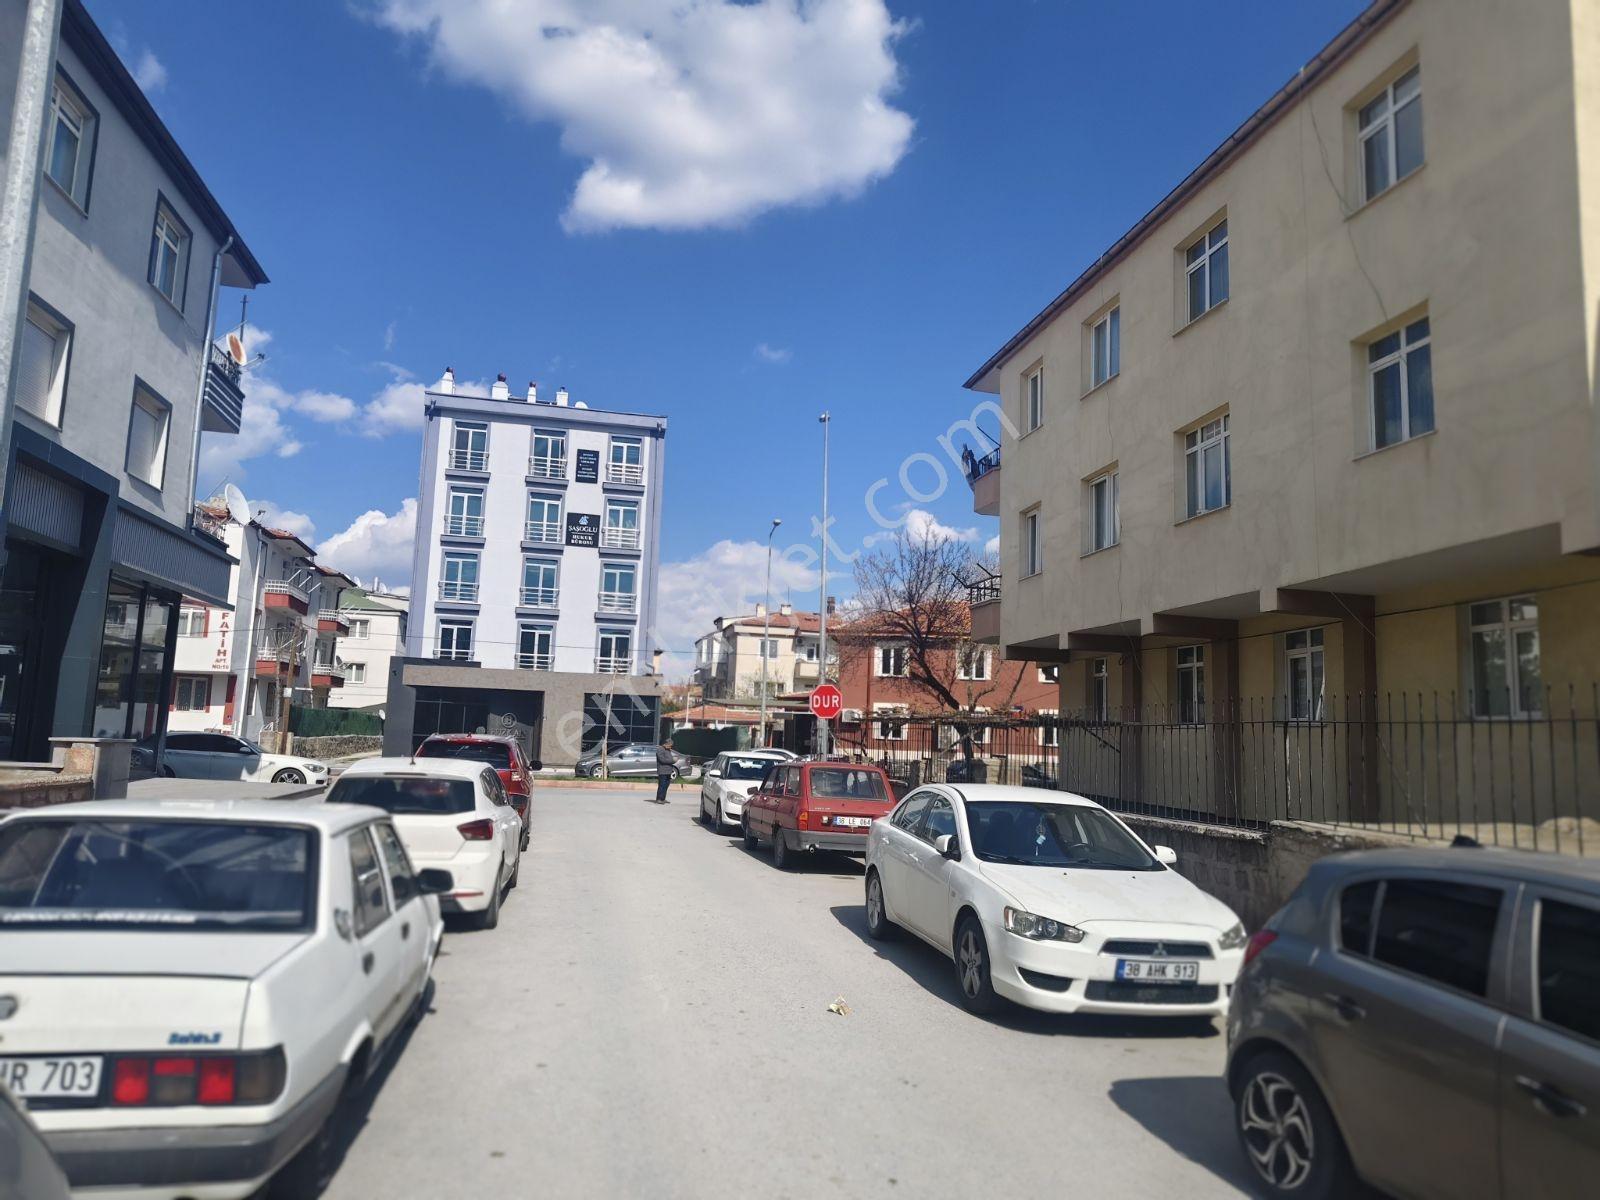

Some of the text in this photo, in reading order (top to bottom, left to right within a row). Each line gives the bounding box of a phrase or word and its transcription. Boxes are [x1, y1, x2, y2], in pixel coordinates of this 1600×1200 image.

[813, 695, 840, 708] DUR
[1126, 963, 1195, 978] 38 AHK 913
[42, 1061, 95, 1091] 703
